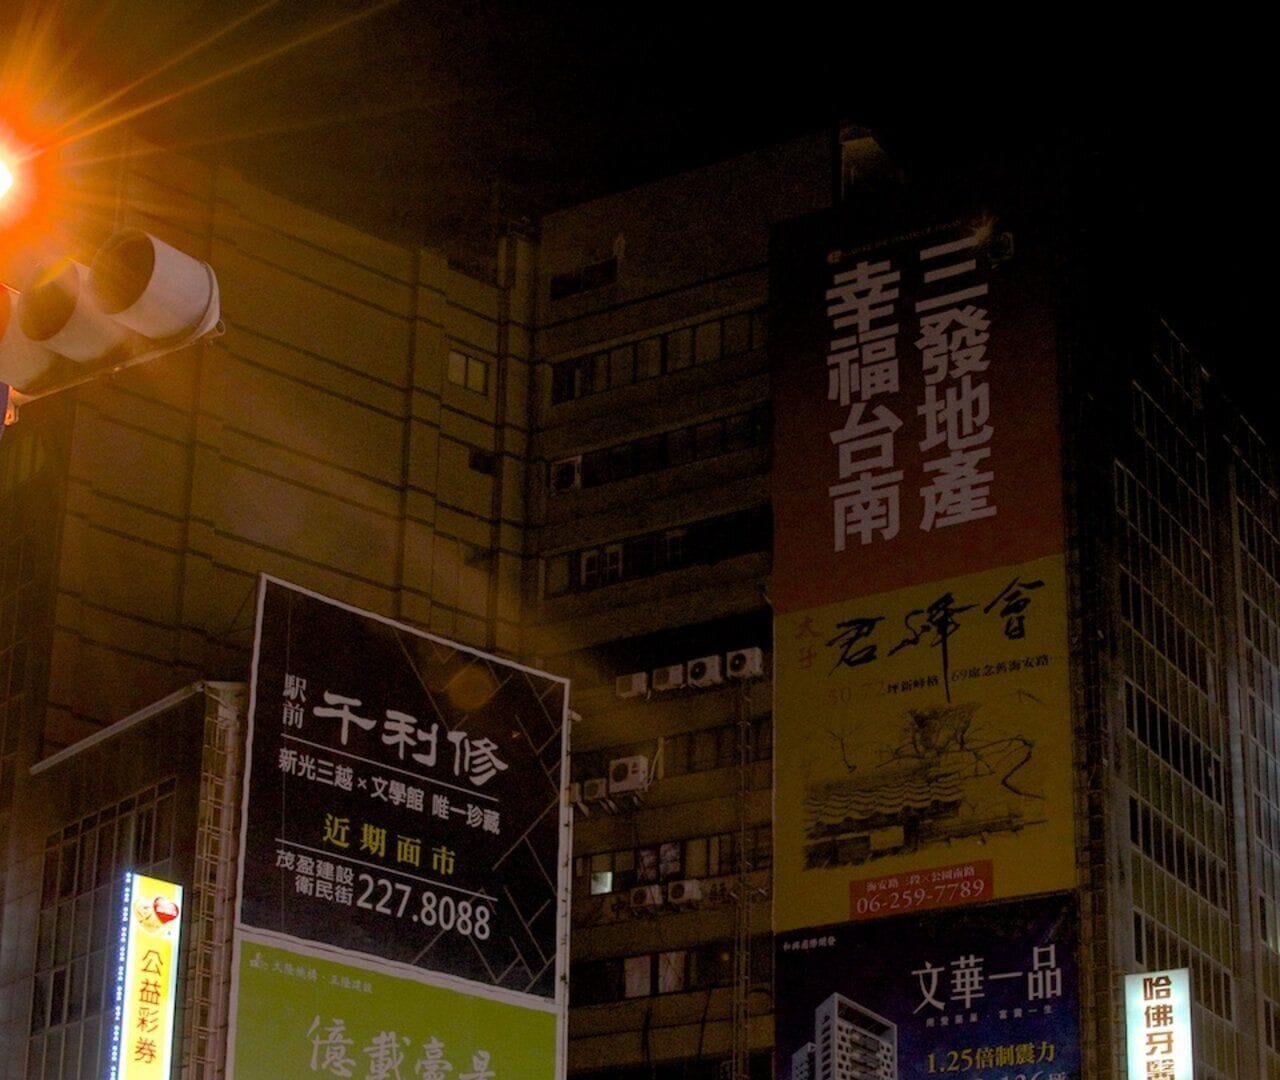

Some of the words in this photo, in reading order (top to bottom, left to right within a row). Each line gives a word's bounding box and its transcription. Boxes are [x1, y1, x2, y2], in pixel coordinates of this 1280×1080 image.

[825, 260, 904, 552] 幸福台南
[914, 236, 997, 532] 三發地產
[314, 690, 508, 786] 千利修
[323, 813, 456, 876] 近期面市
[356, 873, 491, 940] 227.8088
[856, 878, 985, 916] 06-259-7789
[134, 950, 163, 1064] 公益彩券
[911, 944, 1063, 1014] 文華一品
